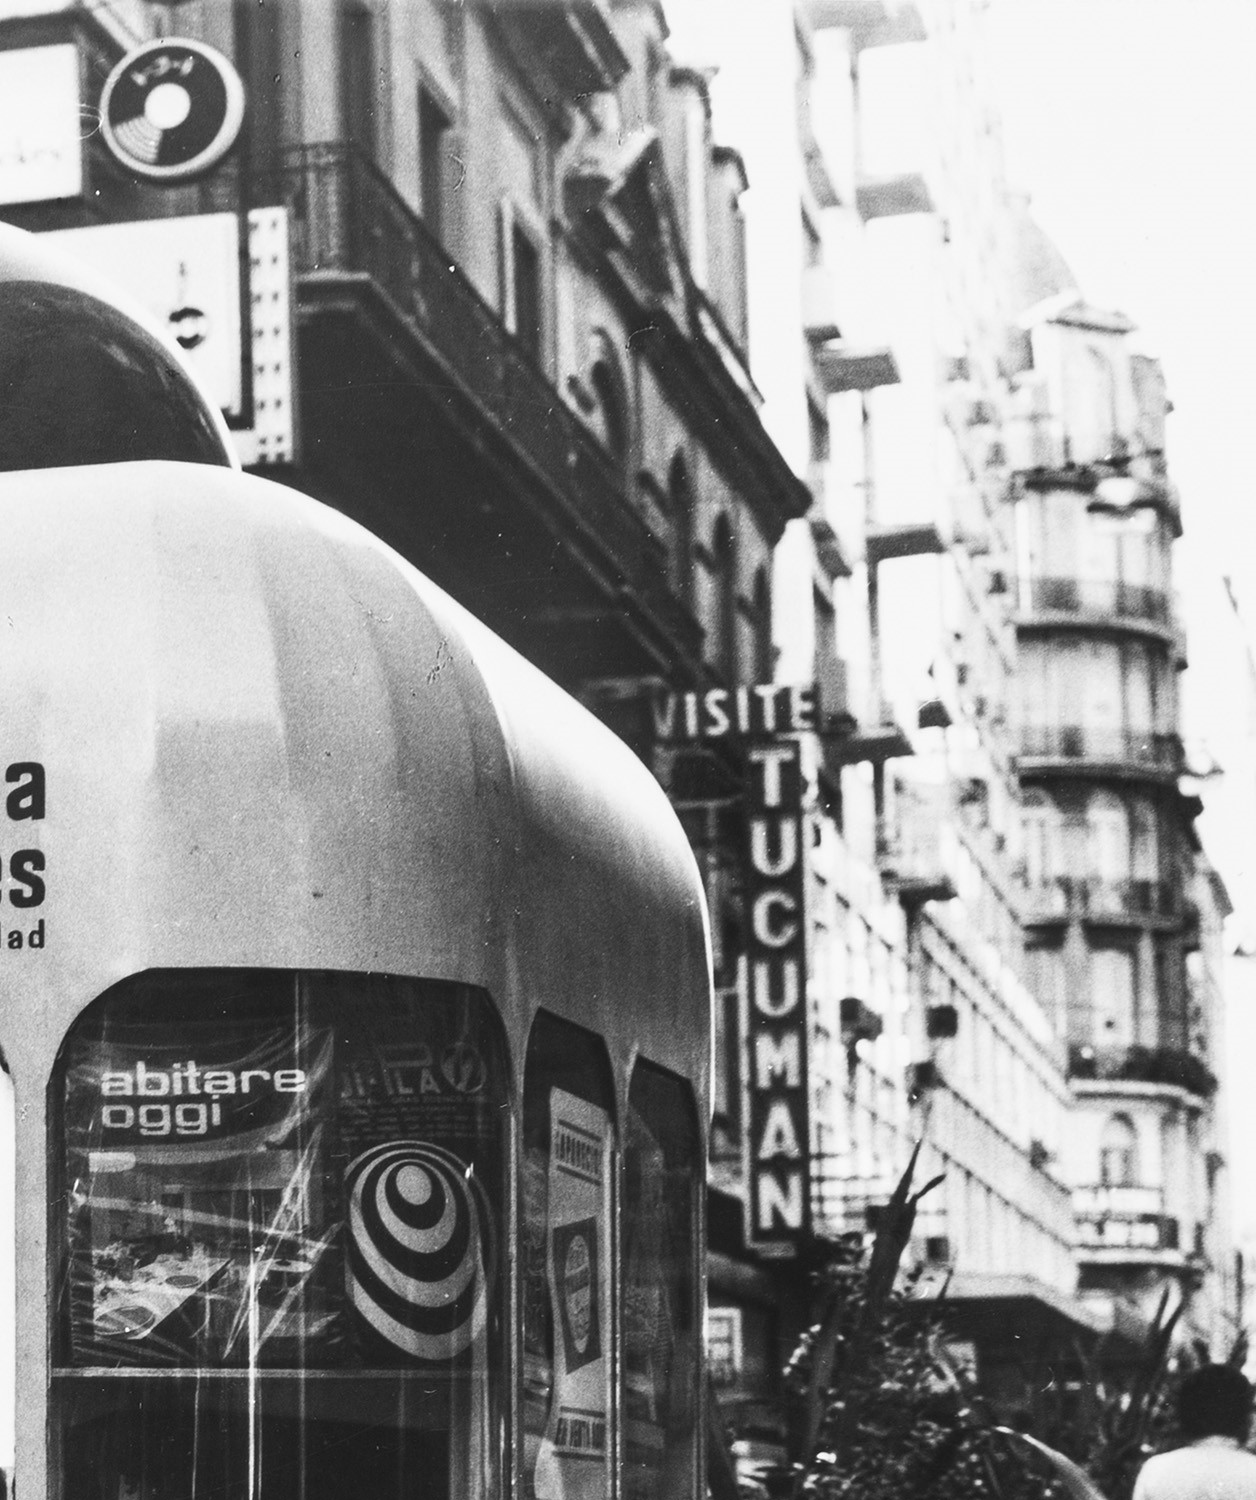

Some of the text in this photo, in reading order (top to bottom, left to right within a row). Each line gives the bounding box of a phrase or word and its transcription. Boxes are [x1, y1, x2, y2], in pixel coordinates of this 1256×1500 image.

[653, 685, 814, 737] VISITE
[749, 749, 803, 1230] TUCUMAN
[101, 1061, 306, 1097] abitare
[102, 1095, 221, 1136] oggi
